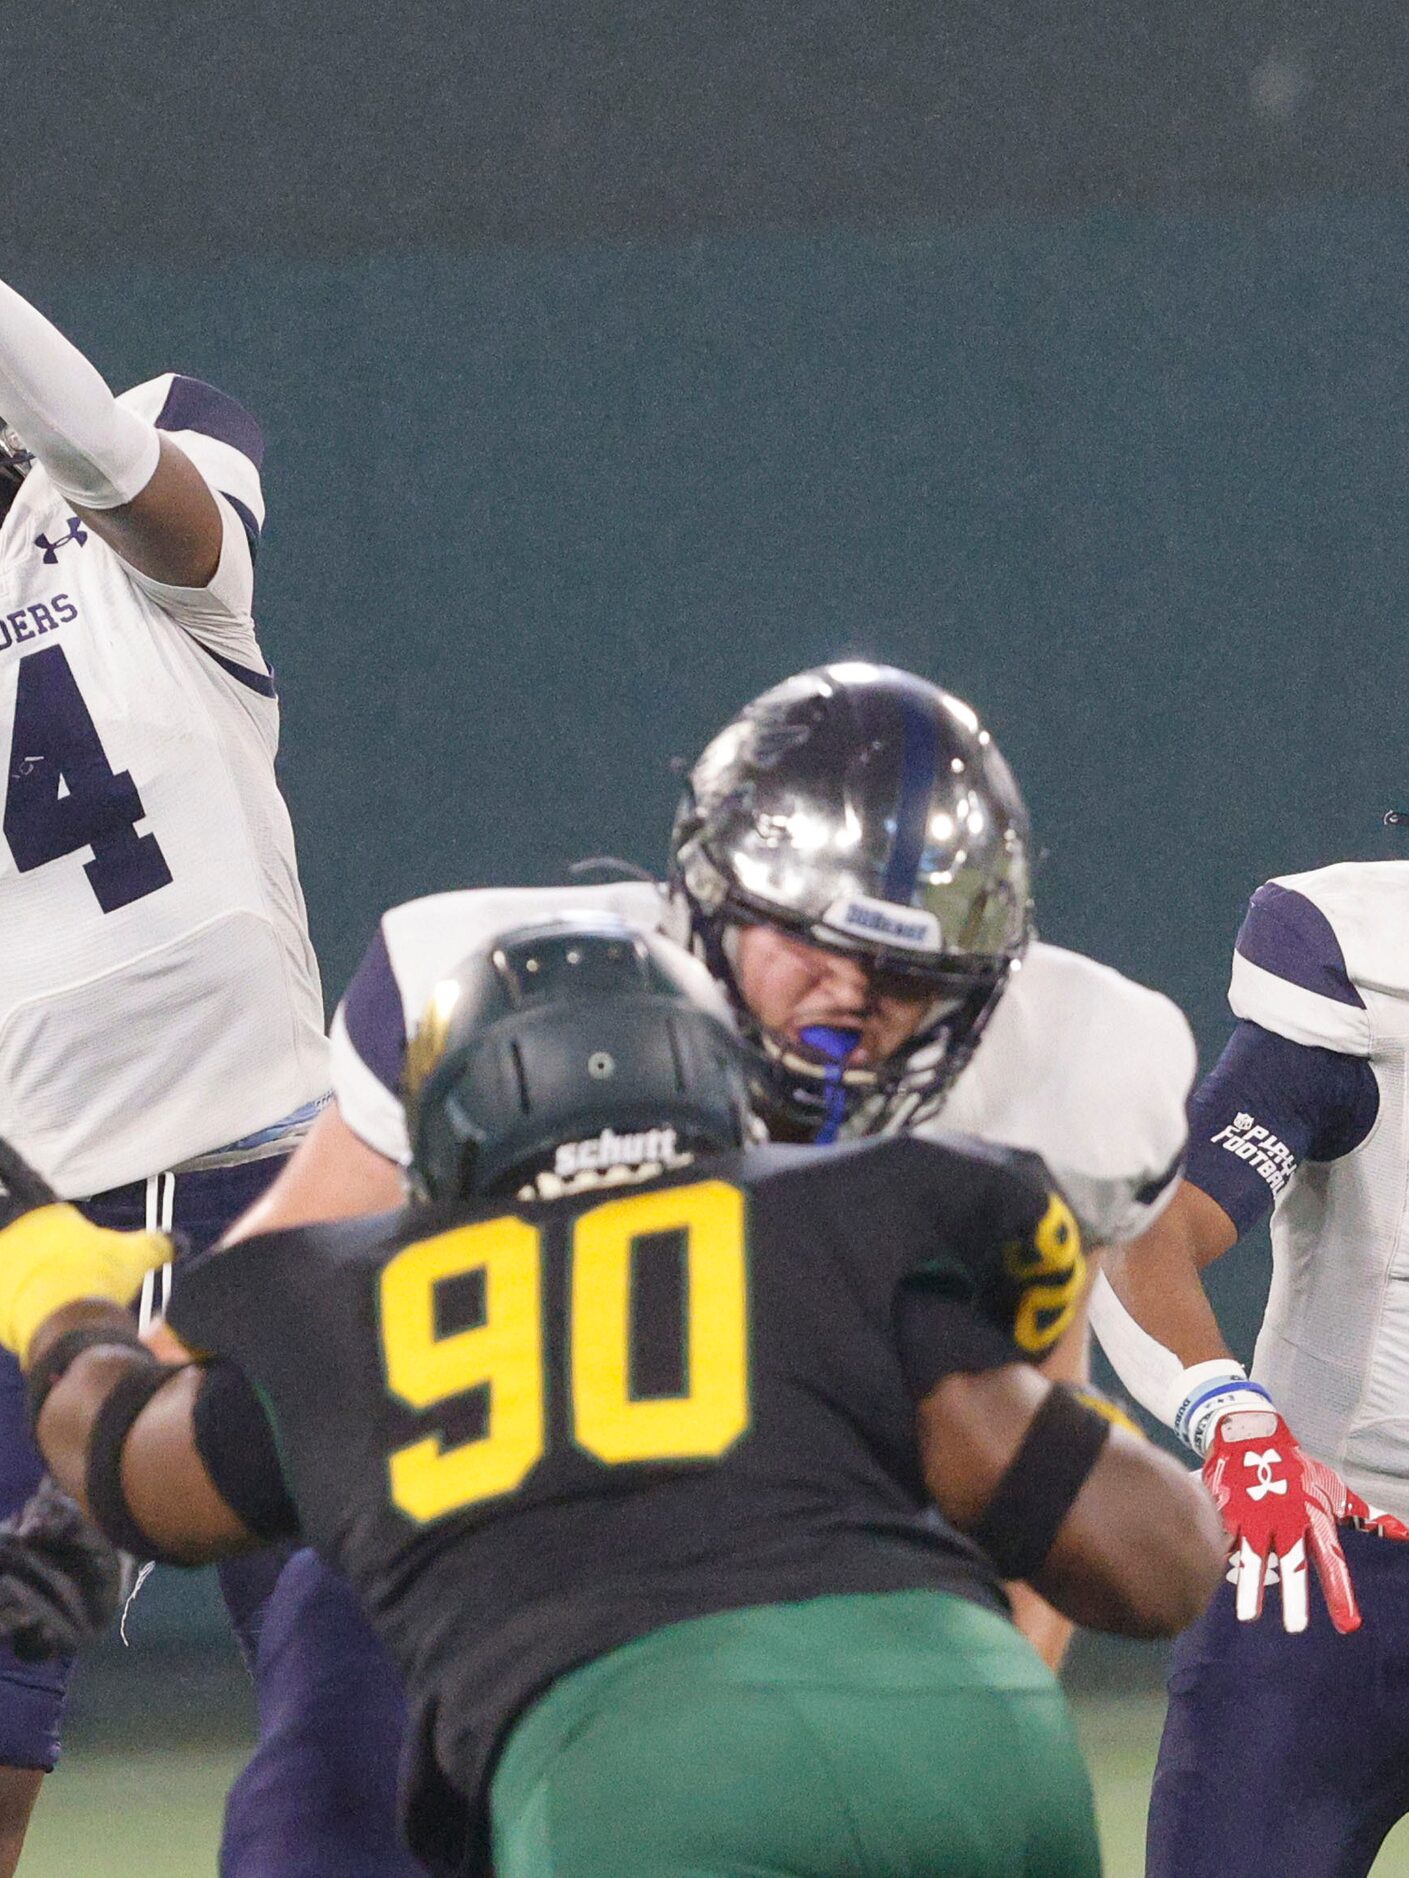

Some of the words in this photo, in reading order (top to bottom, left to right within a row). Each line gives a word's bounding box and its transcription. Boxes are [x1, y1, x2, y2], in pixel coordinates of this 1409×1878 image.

[3, 643, 174, 914] 4
[1210, 1125, 1287, 1200] FOOTBAL
[1242, 1125, 1297, 1176] PLAY
[378, 1178, 750, 1525] 90
